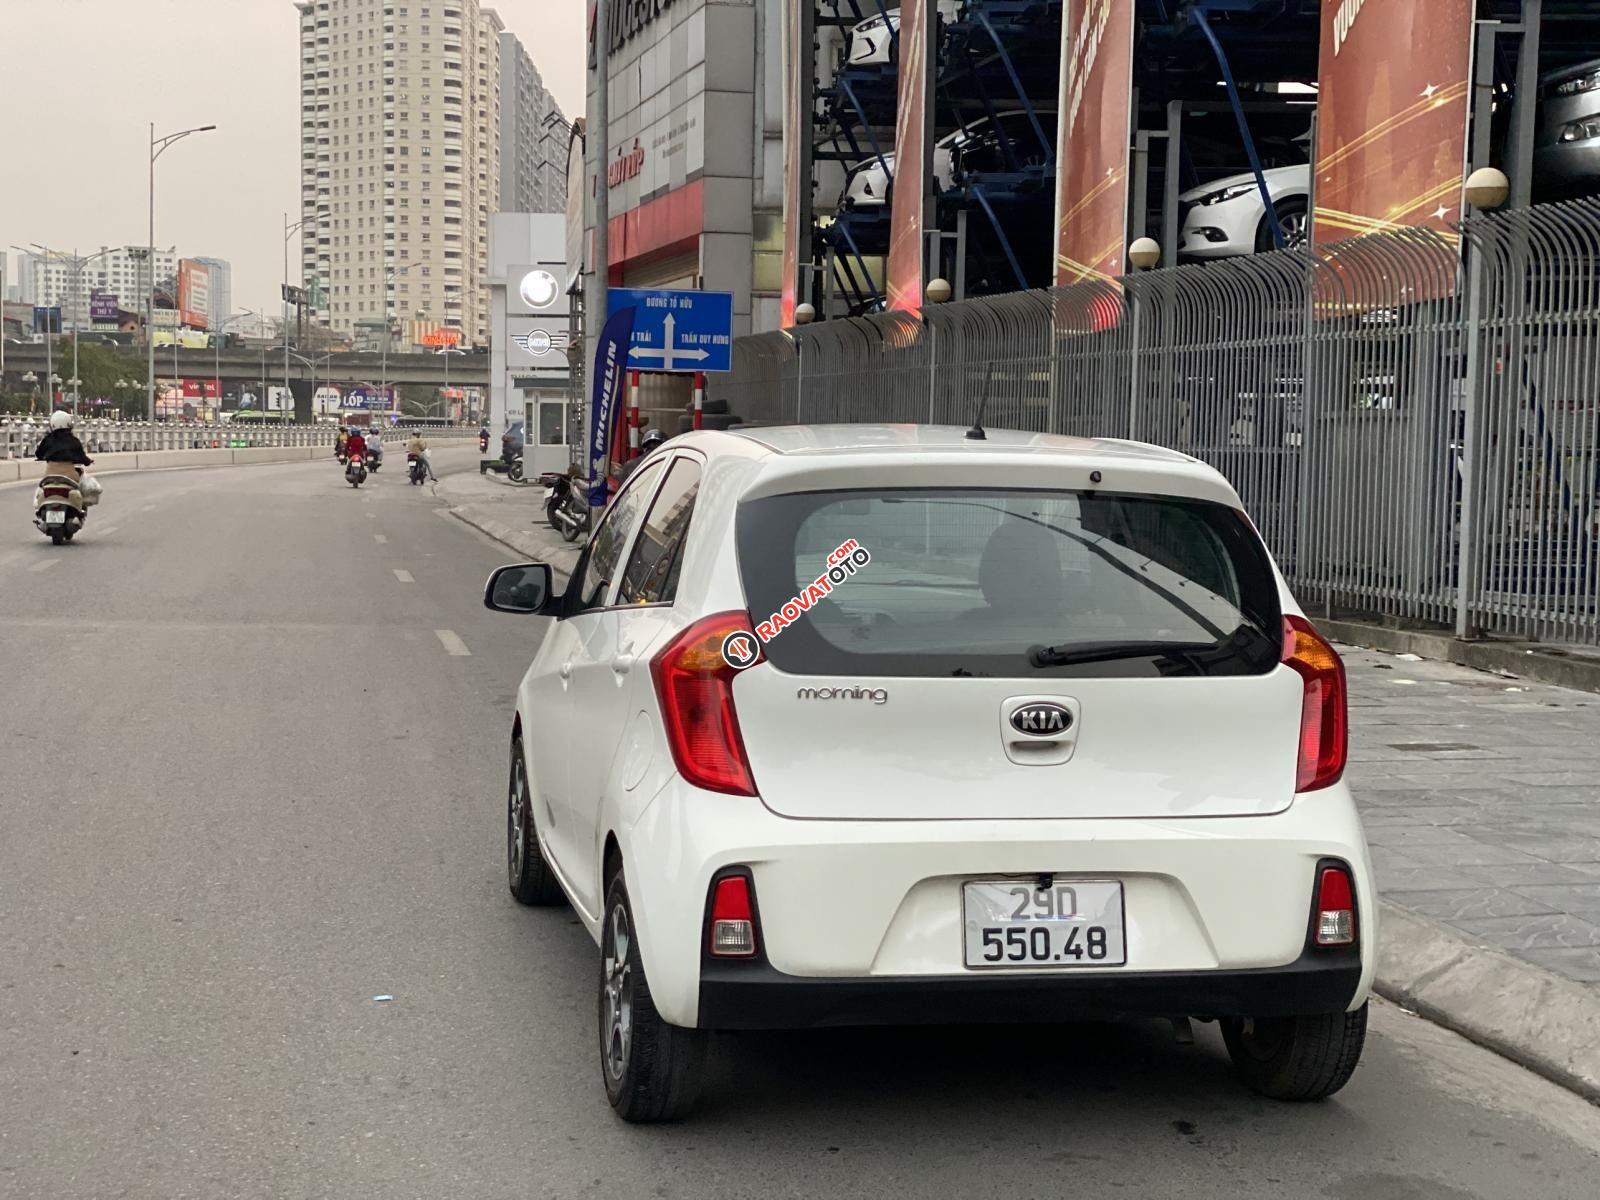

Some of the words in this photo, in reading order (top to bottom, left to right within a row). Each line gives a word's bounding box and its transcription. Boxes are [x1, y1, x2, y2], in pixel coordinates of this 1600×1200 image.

[595, 340, 617, 452] MICHELIN
[797, 685, 888, 705] morning
[1021, 711, 1064, 730] KIA
[1009, 886, 1078, 921] 29D
[982, 925, 1108, 962] 550.48
